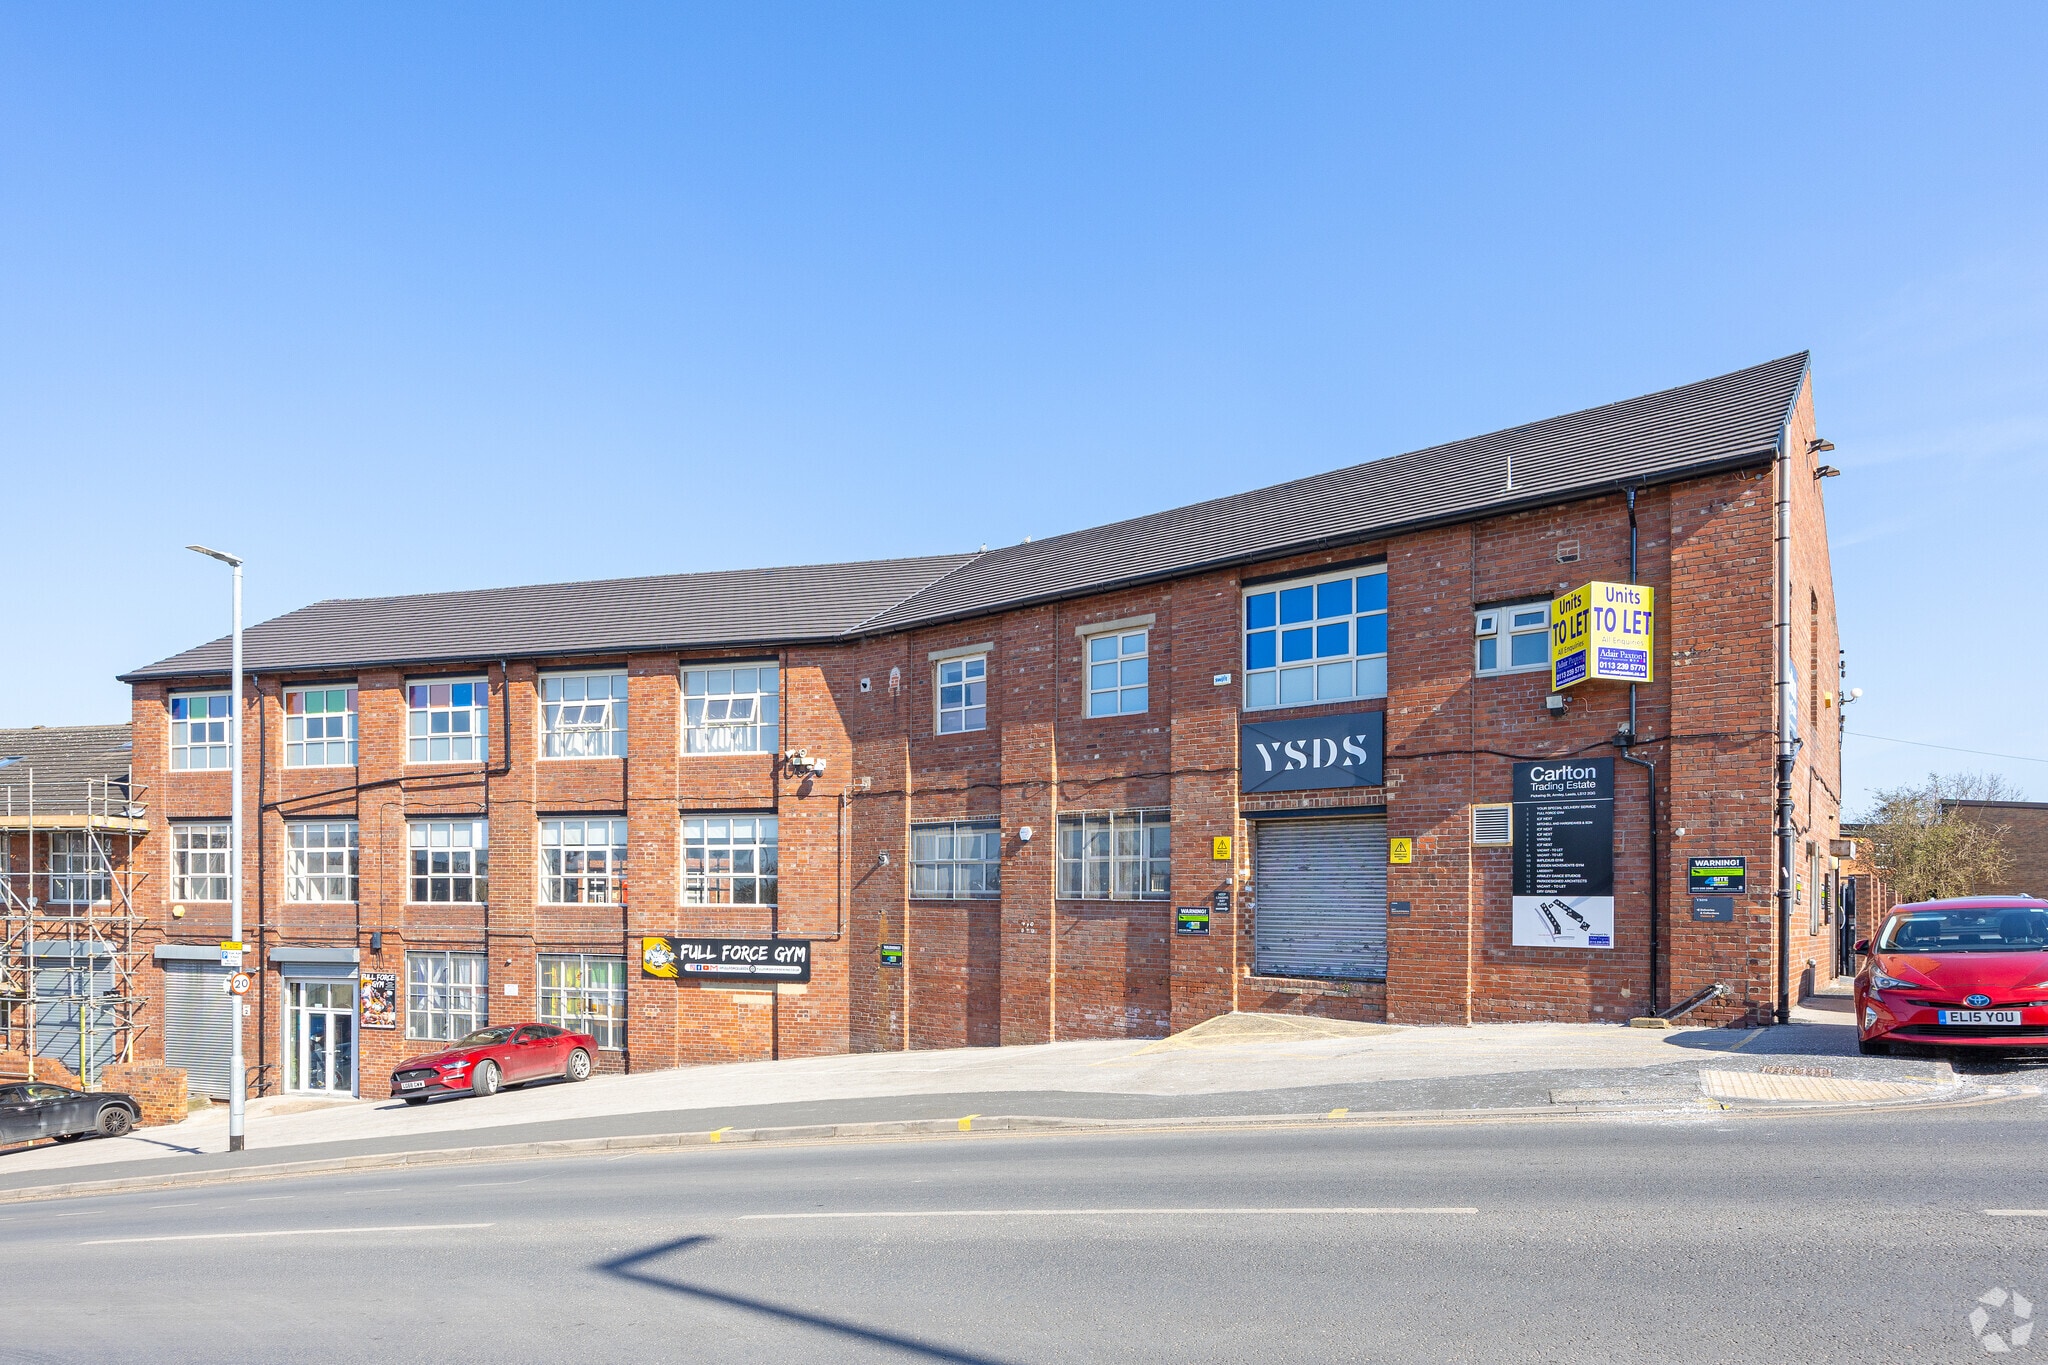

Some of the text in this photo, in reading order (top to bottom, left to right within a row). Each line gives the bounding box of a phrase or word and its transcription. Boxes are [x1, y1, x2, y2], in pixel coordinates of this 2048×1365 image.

[1606, 586, 1640, 604] Units
[1560, 594, 1582, 615] Units
[1553, 608, 1589, 646] TO LET
[1594, 607, 1652, 635] TO LET
[1564, 640, 1584, 654] Enquiries
[1613, 637, 1644, 646] Enquiries
[1600, 649, 1618, 657] Adair
[1575, 664, 1585, 674] 5770
[1256, 735, 1367, 771] YSDS
[1530, 765, 1596, 782] Carlton
[1531, 781, 1596, 791] Trading Estate
[680, 944, 806, 963] FULL FORCE GYM
[235, 979, 248, 988] 20
[1986, 1012, 2014, 1022] YOU
